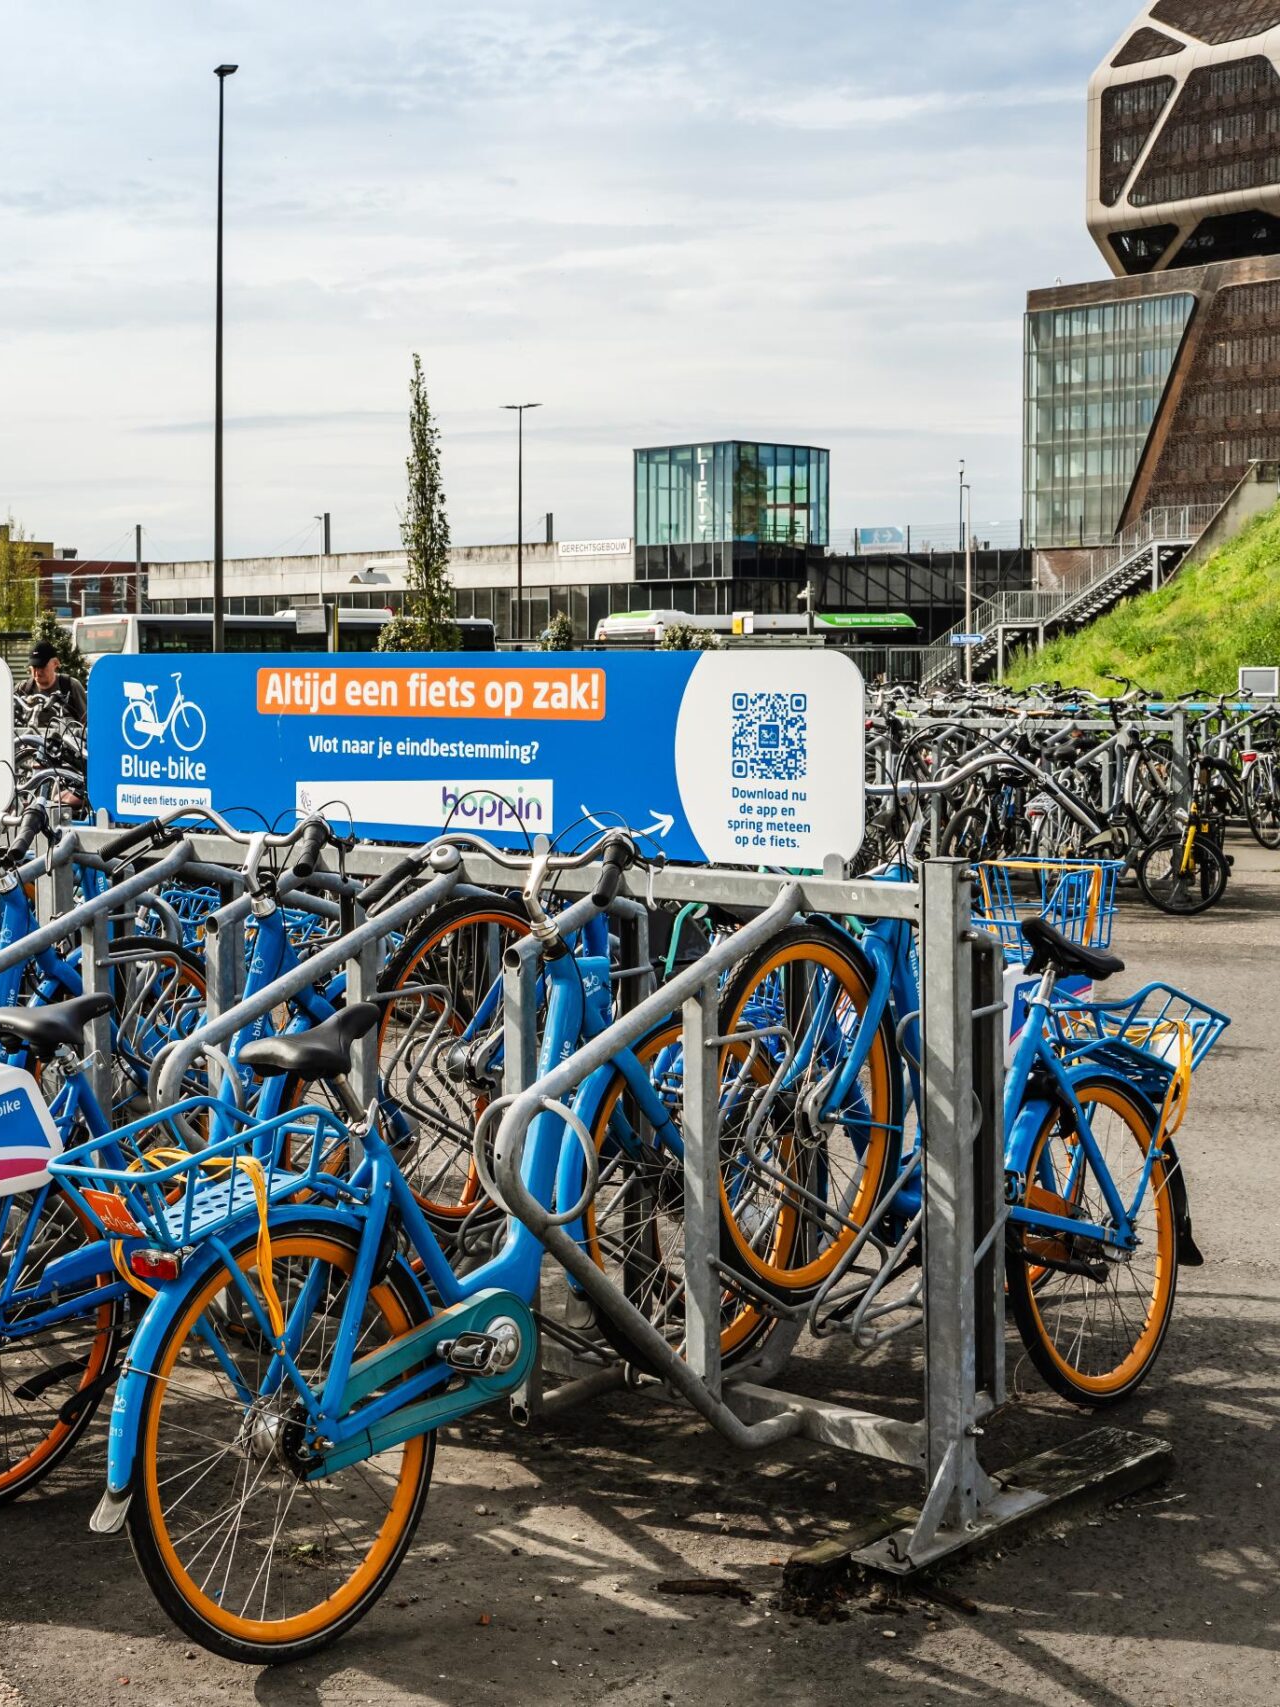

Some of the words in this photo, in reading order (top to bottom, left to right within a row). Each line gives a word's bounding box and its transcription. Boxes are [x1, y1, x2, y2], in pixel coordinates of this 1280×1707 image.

[697, 447, 707, 515] LIFT
[562, 542, 627, 553] GERECHTSGEBOUW
[265, 672, 337, 712] Altijd
[345, 680, 398, 707] een
[407, 673, 476, 708] fiets
[485, 682, 523, 716] op
[533, 673, 599, 710] zak!
[309, 735, 338, 753] Vlot
[342, 739, 375, 755] naar
[378, 737, 392, 758] je
[396, 738, 539, 764] eindbestemming?
[121, 754, 206, 781] Blue-bike
[121, 793, 141, 807] Altijd
[143, 795, 157, 805] een
[159, 795, 177, 807] fiets
[732, 787, 788, 801] Download
[791, 791, 807, 802] nu
[442, 786, 542, 826] hoppin
[739, 803, 753, 814] de
[756, 805, 778, 817] app
[781, 806, 795, 816] en
[727, 818, 763, 832] spring
[766, 821, 811, 833] meteen
[735, 836, 749, 847] op
[752, 834, 766, 846] de
[770, 835, 800, 848] fiets.
